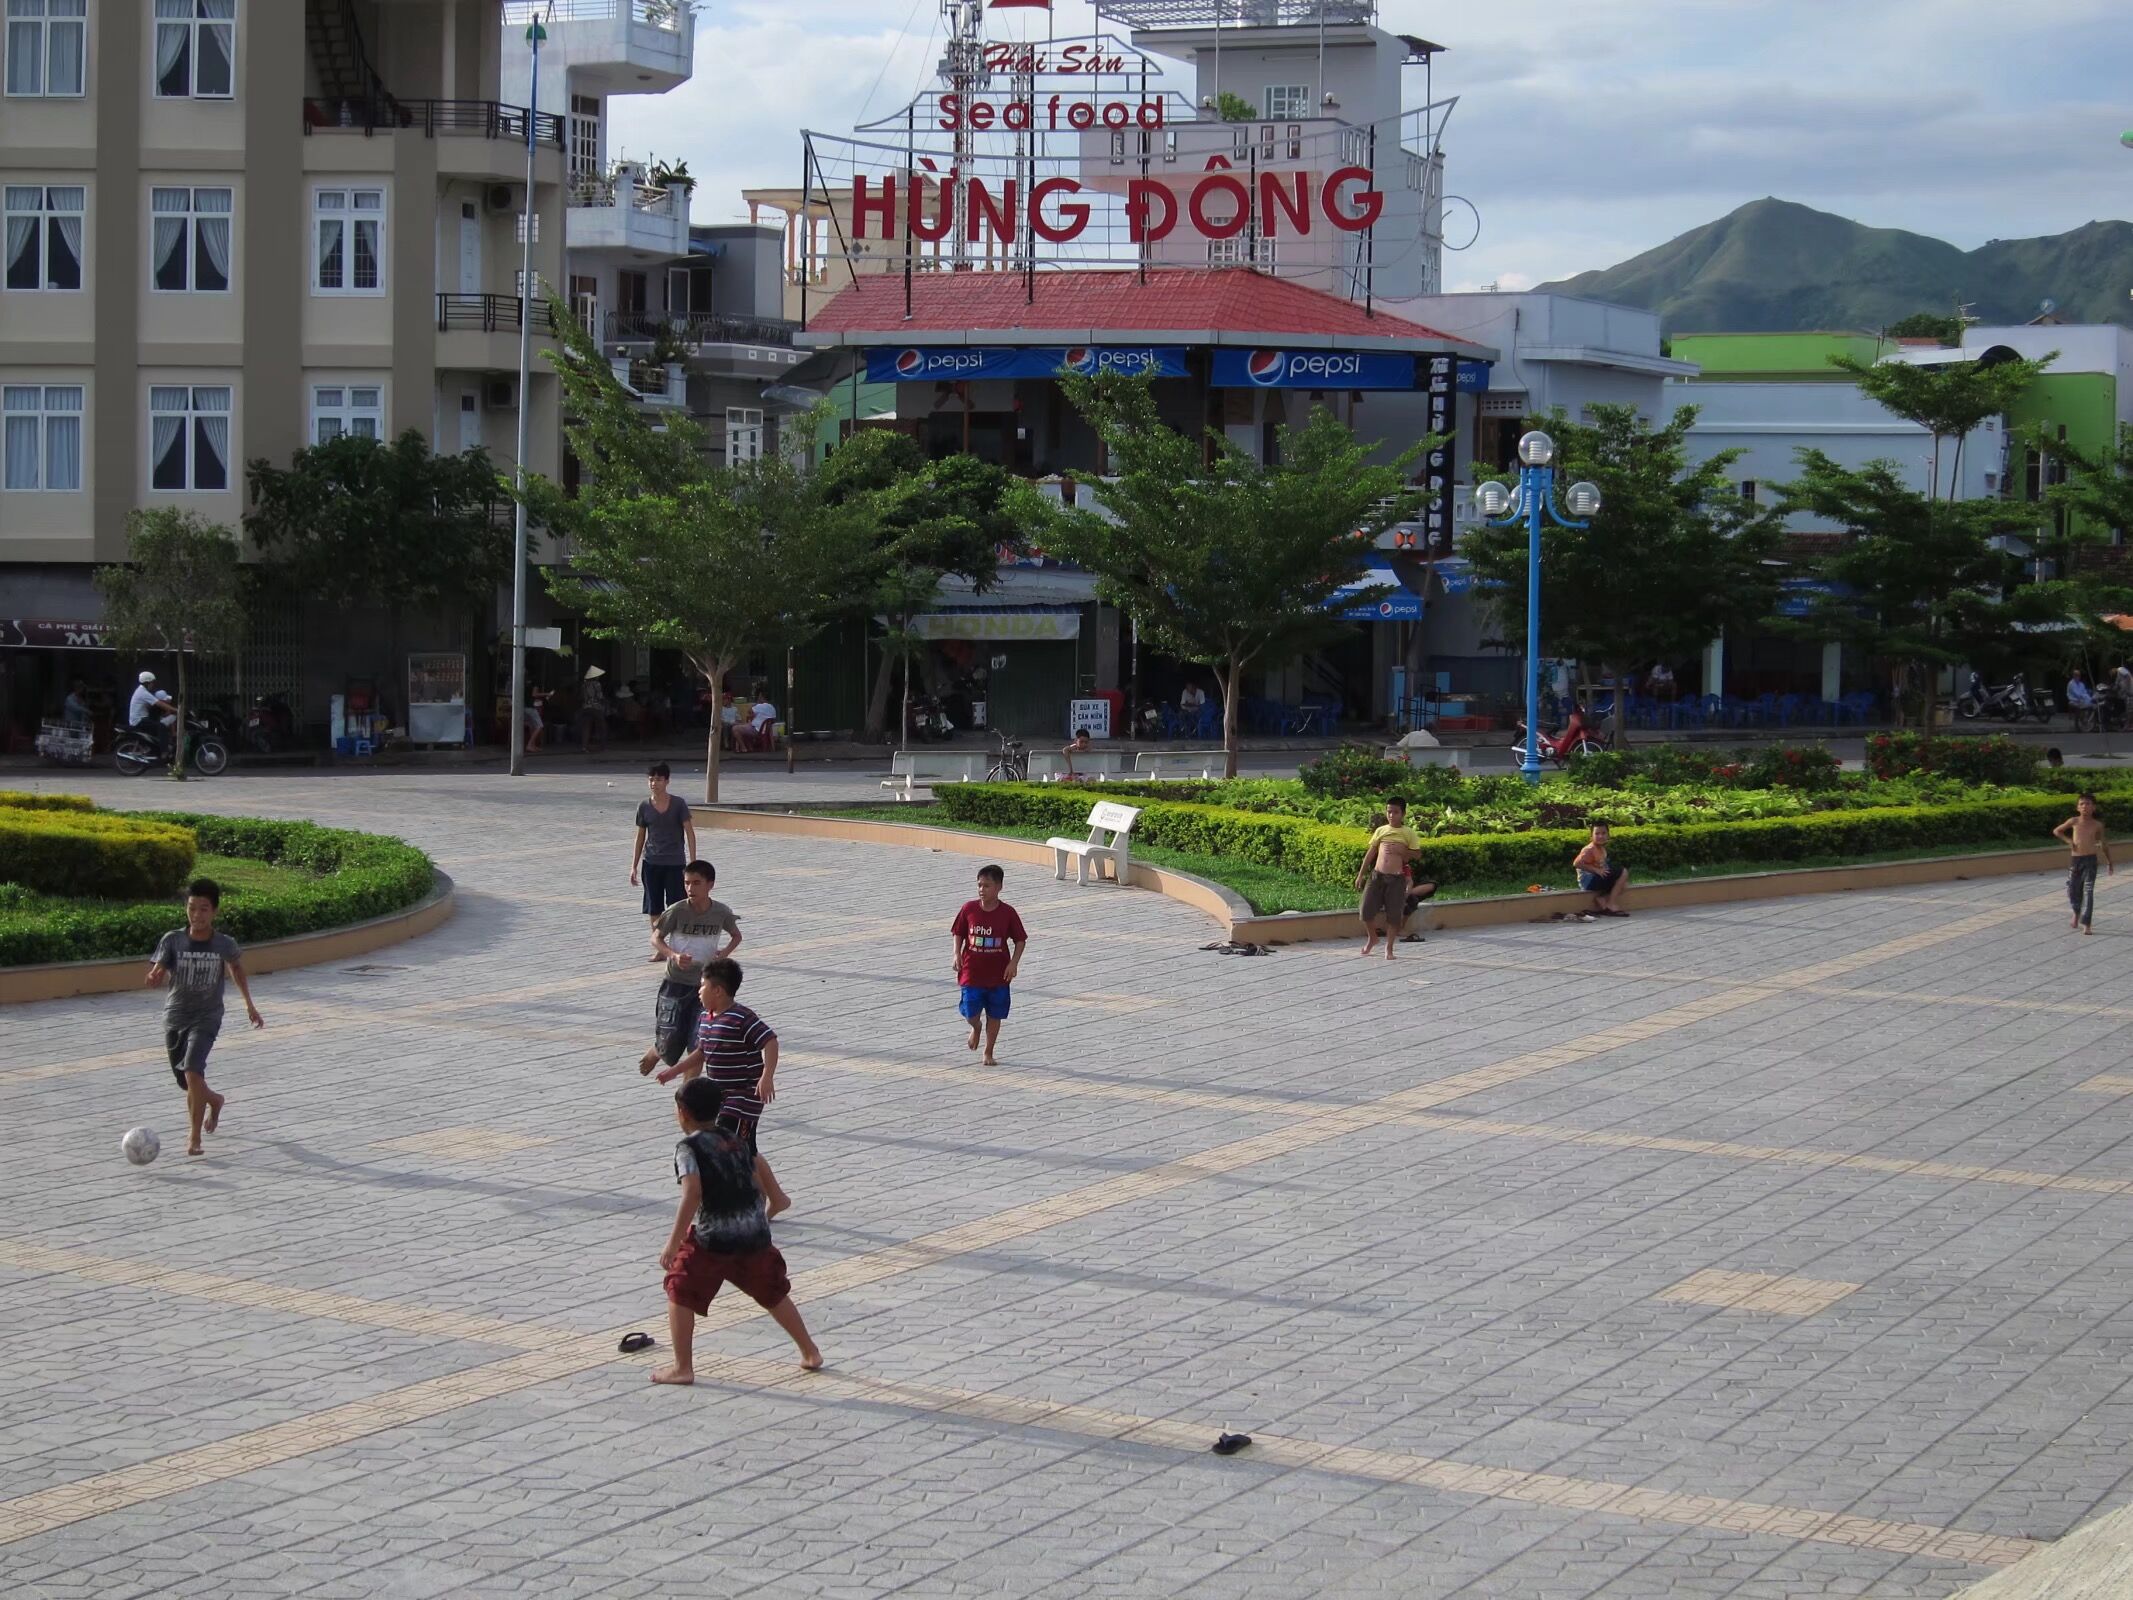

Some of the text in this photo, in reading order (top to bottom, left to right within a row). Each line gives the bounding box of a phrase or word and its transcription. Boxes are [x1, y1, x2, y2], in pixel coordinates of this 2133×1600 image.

[983, 43, 1125, 73] Hải Sản
[1125, 154, 1384, 243] ĐÔNG
[928, 351, 983, 372] pepsi
[1099, 348, 1154, 369] pepsi
[1290, 354, 1360, 379] pepsi
[1456, 371, 1476, 384] pepsi
[1394, 605, 1417, 615] pepsi
[928, 615, 1058, 636] HONDA
